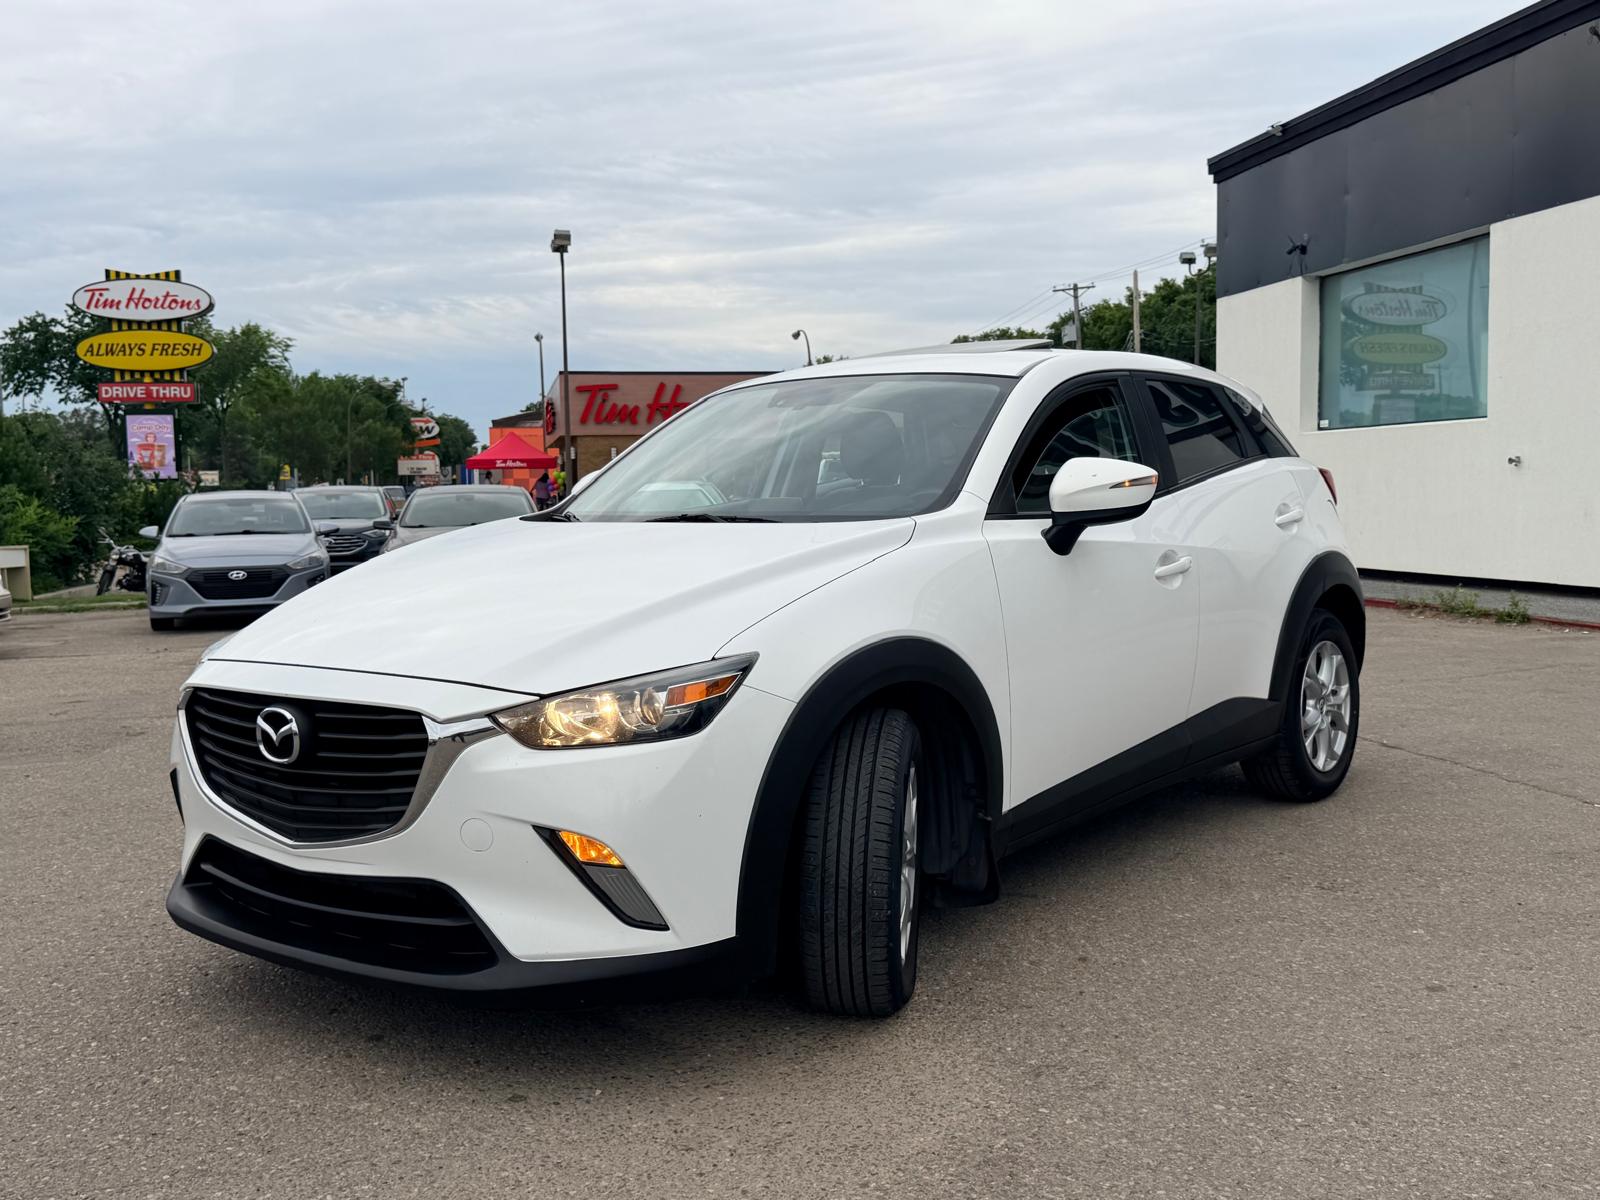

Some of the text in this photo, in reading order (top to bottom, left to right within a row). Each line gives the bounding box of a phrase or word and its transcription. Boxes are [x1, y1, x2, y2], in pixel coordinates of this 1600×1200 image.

[84, 287, 201, 311] Tim Hortons
[83, 342, 204, 357] ALWAYS FRESH
[101, 386, 192, 399] DRIVE THRU
[575, 383, 640, 425] Tim
